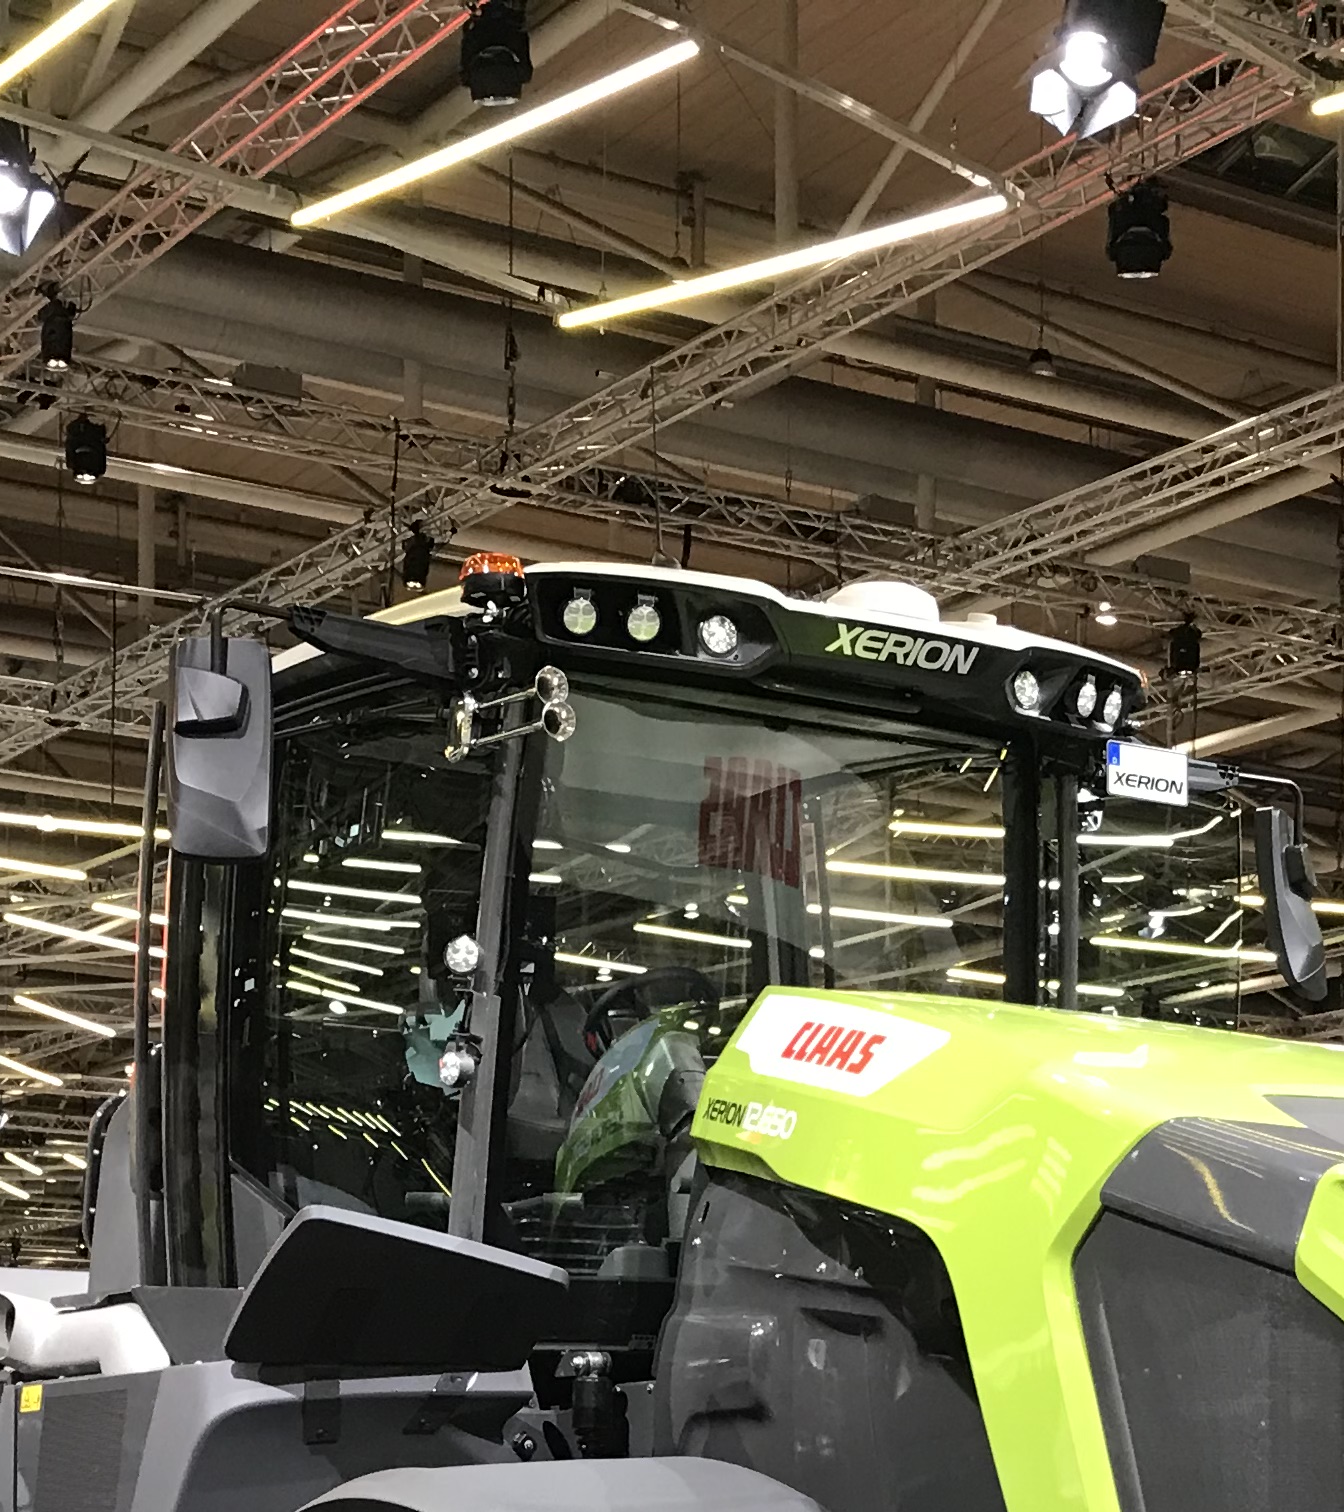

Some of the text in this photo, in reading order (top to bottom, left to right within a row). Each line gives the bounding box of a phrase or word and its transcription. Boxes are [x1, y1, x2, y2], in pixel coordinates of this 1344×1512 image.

[825, 622, 980, 675] XERION
[1113, 771, 1184, 795] XERION
[781, 1021, 887, 1074] CLAAS
[702, 1097, 747, 1128] XERION
